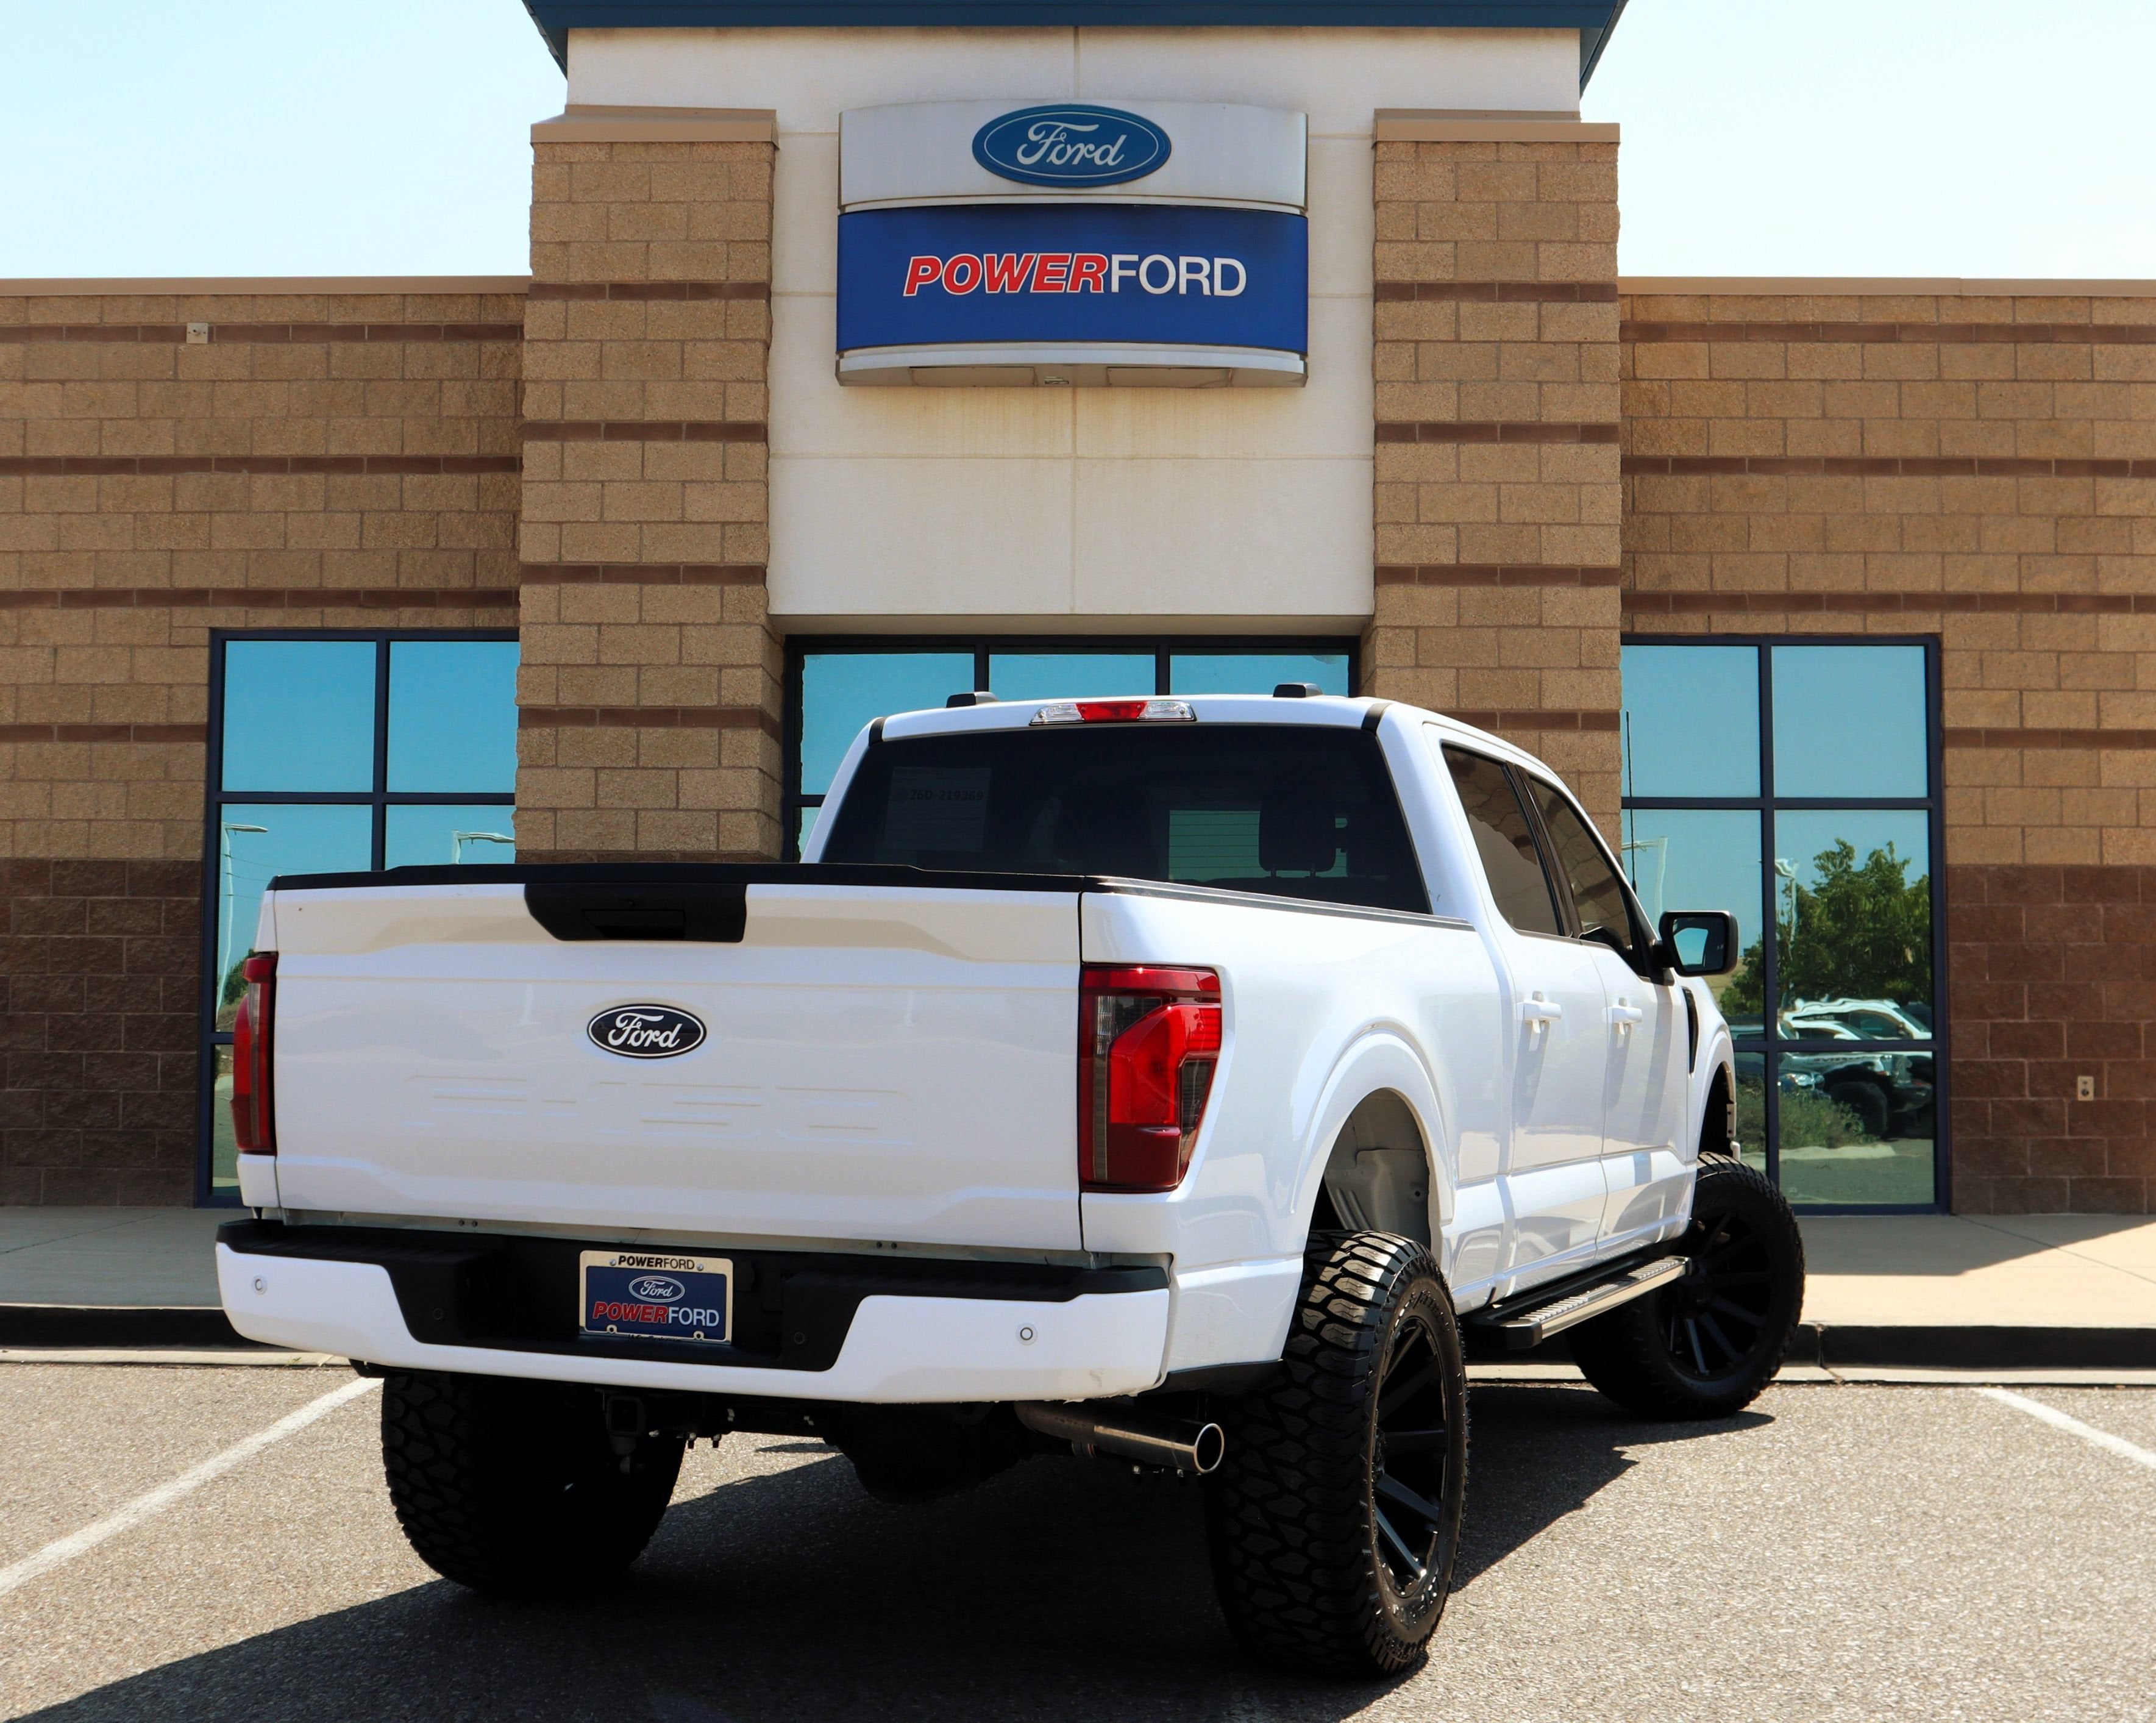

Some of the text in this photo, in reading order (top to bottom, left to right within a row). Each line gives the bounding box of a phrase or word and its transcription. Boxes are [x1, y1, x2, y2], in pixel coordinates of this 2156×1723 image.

[1016, 121, 1127, 166] Ford
[903, 253, 1247, 298] POWERFORD
[608, 1013, 683, 1048] Ford
[618, 1255, 695, 1270] POWERFORD
[640, 1280, 673, 1297] Ford
[592, 1302, 720, 1327] POWERFORD
